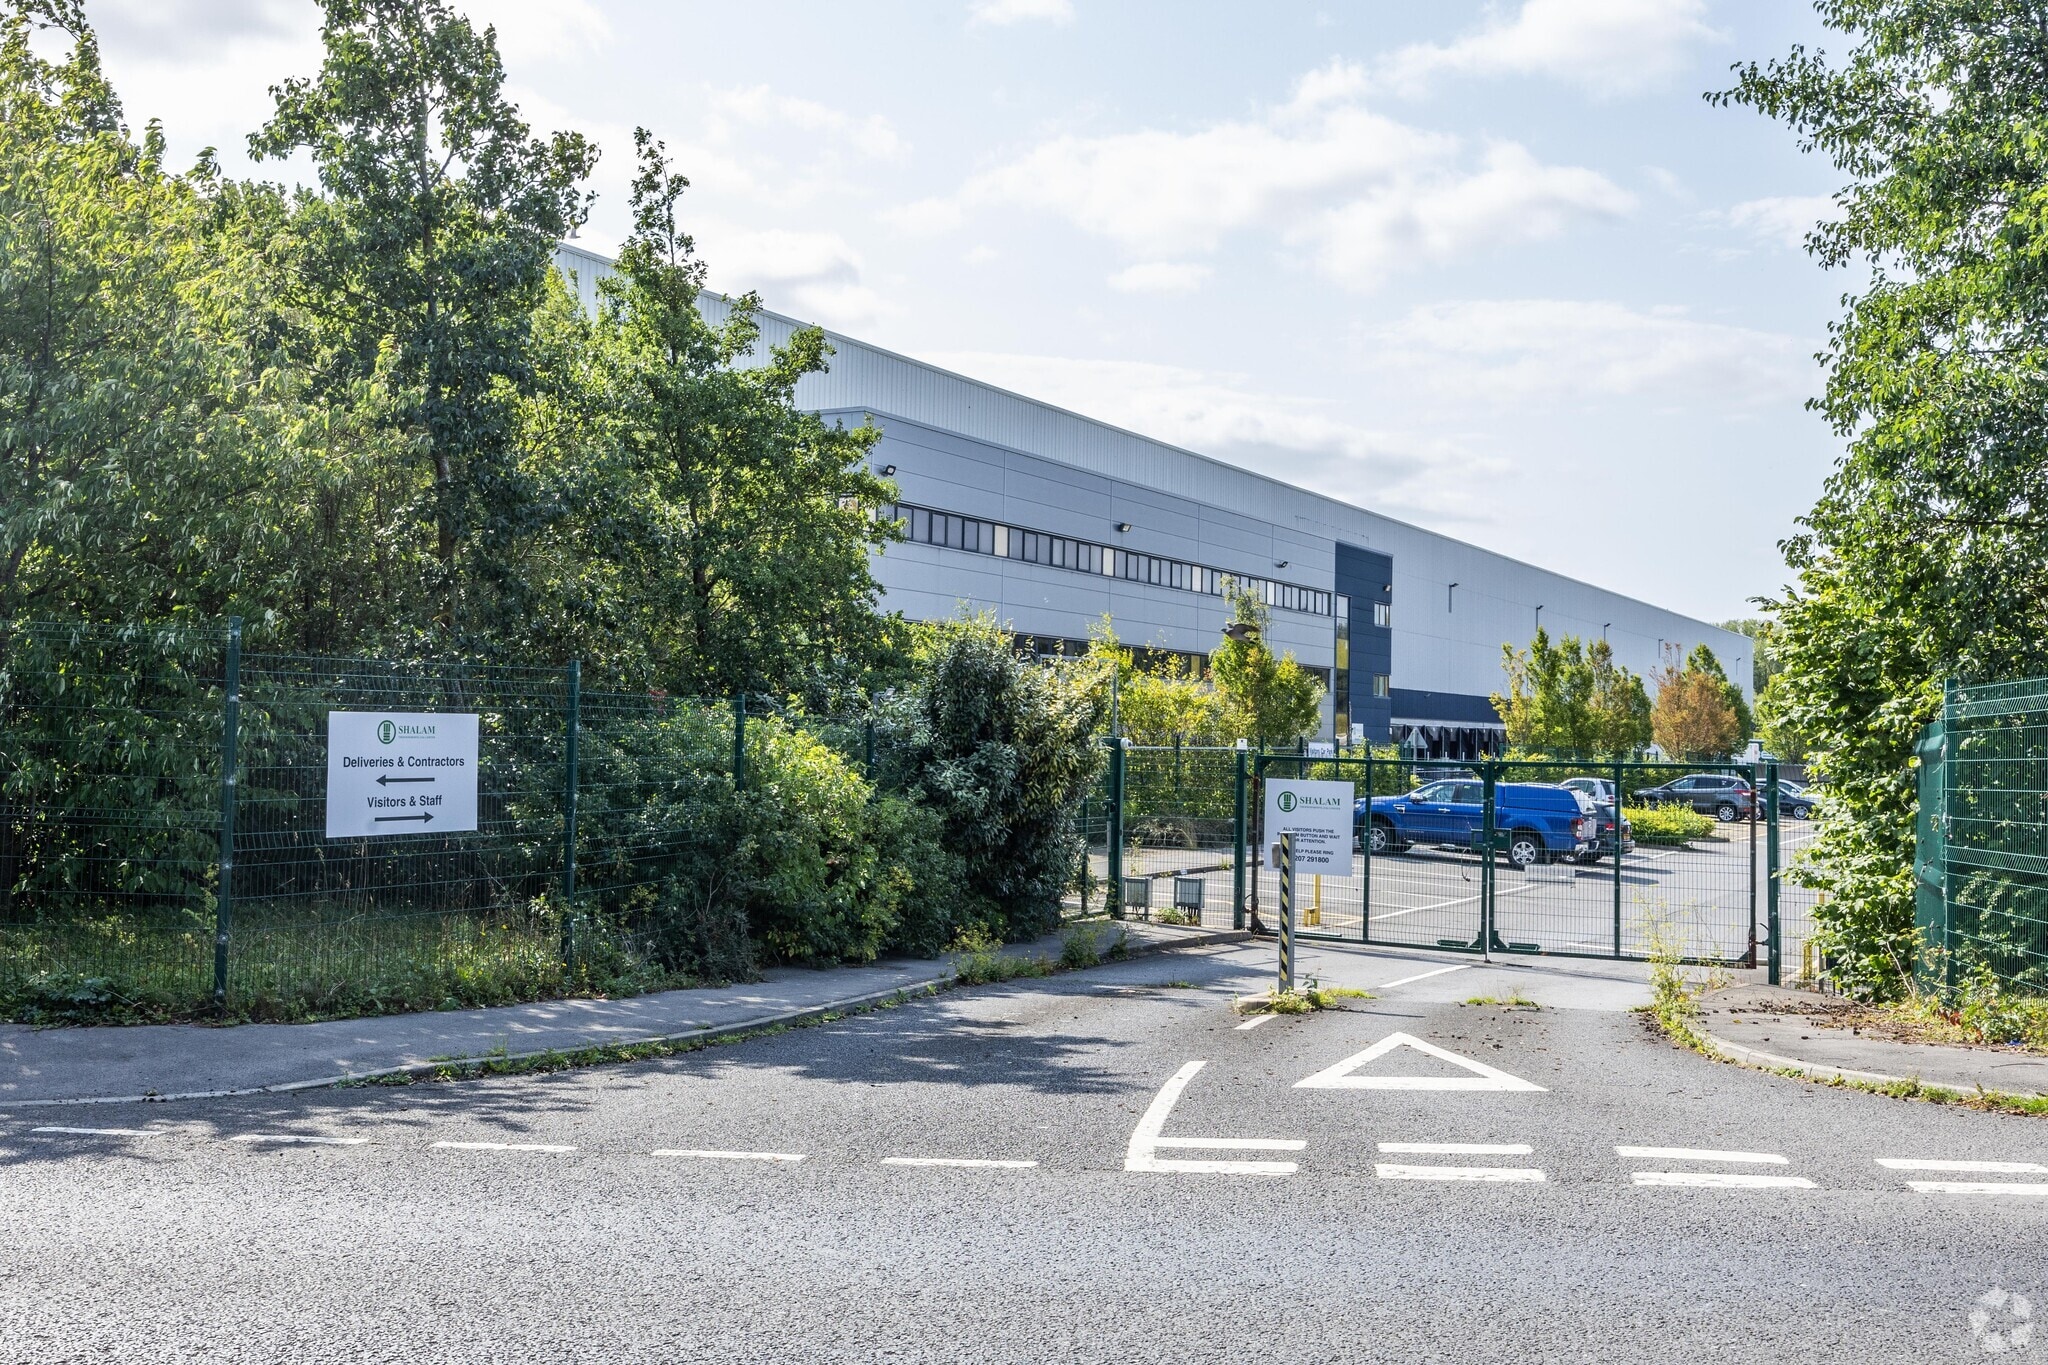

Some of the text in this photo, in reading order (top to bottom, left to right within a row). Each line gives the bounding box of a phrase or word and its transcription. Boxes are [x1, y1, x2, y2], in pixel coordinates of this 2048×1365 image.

[398, 725, 435, 734] SHALAM
[343, 756, 465, 768] Deliveries & Contractors
[367, 795, 443, 808] Visitors & Staff
[1299, 796, 1340, 806] SHALAM
[1306, 856, 1330, 864] 291800
